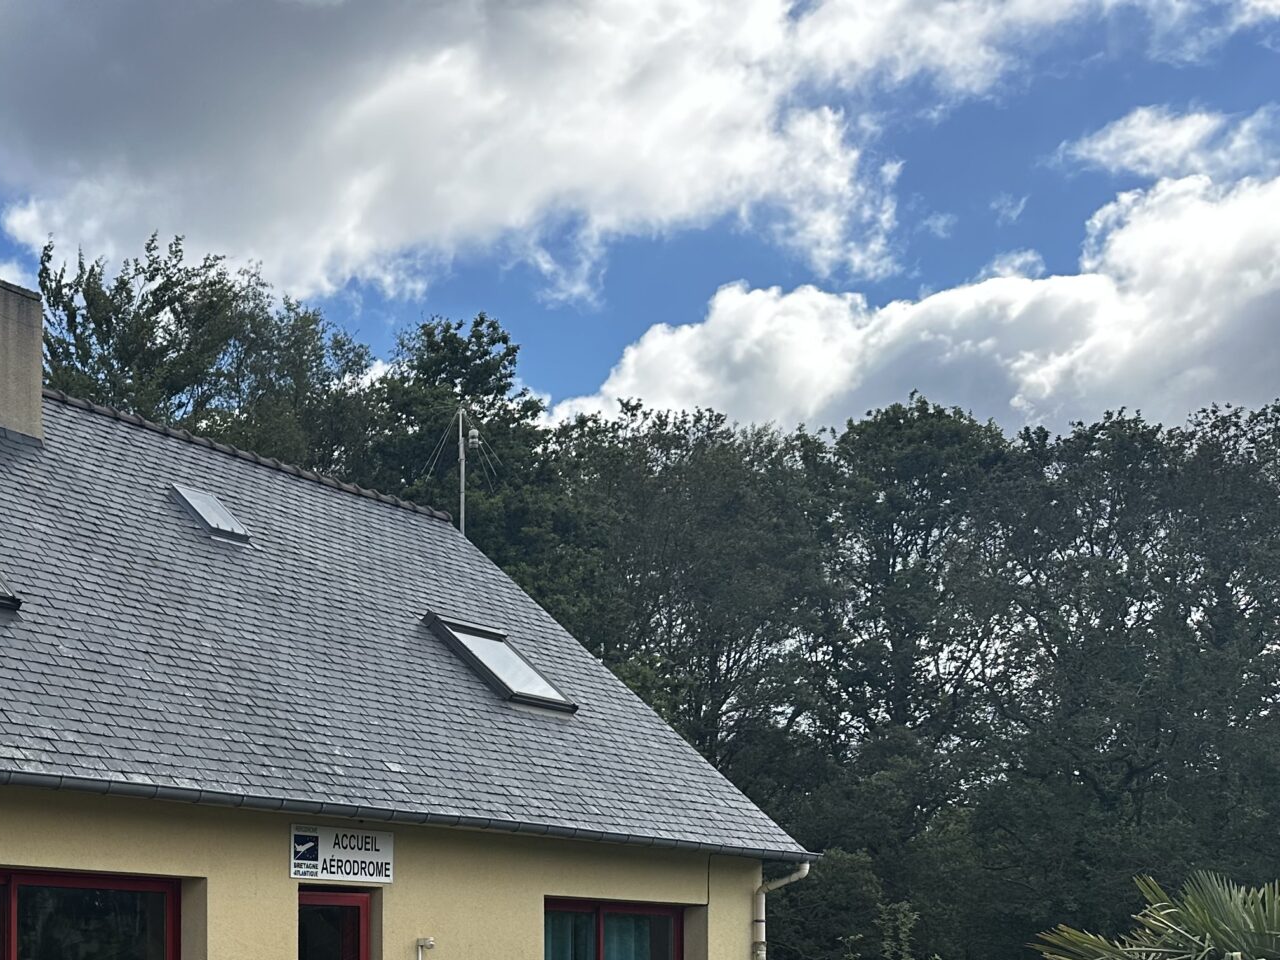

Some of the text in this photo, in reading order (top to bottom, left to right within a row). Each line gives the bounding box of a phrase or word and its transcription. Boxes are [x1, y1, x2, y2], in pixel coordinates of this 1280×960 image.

[332, 833, 380, 852] ACCUEIL
[293, 862, 318, 870] BRETAGNE
[321, 855, 390, 877] AÉRODROME
